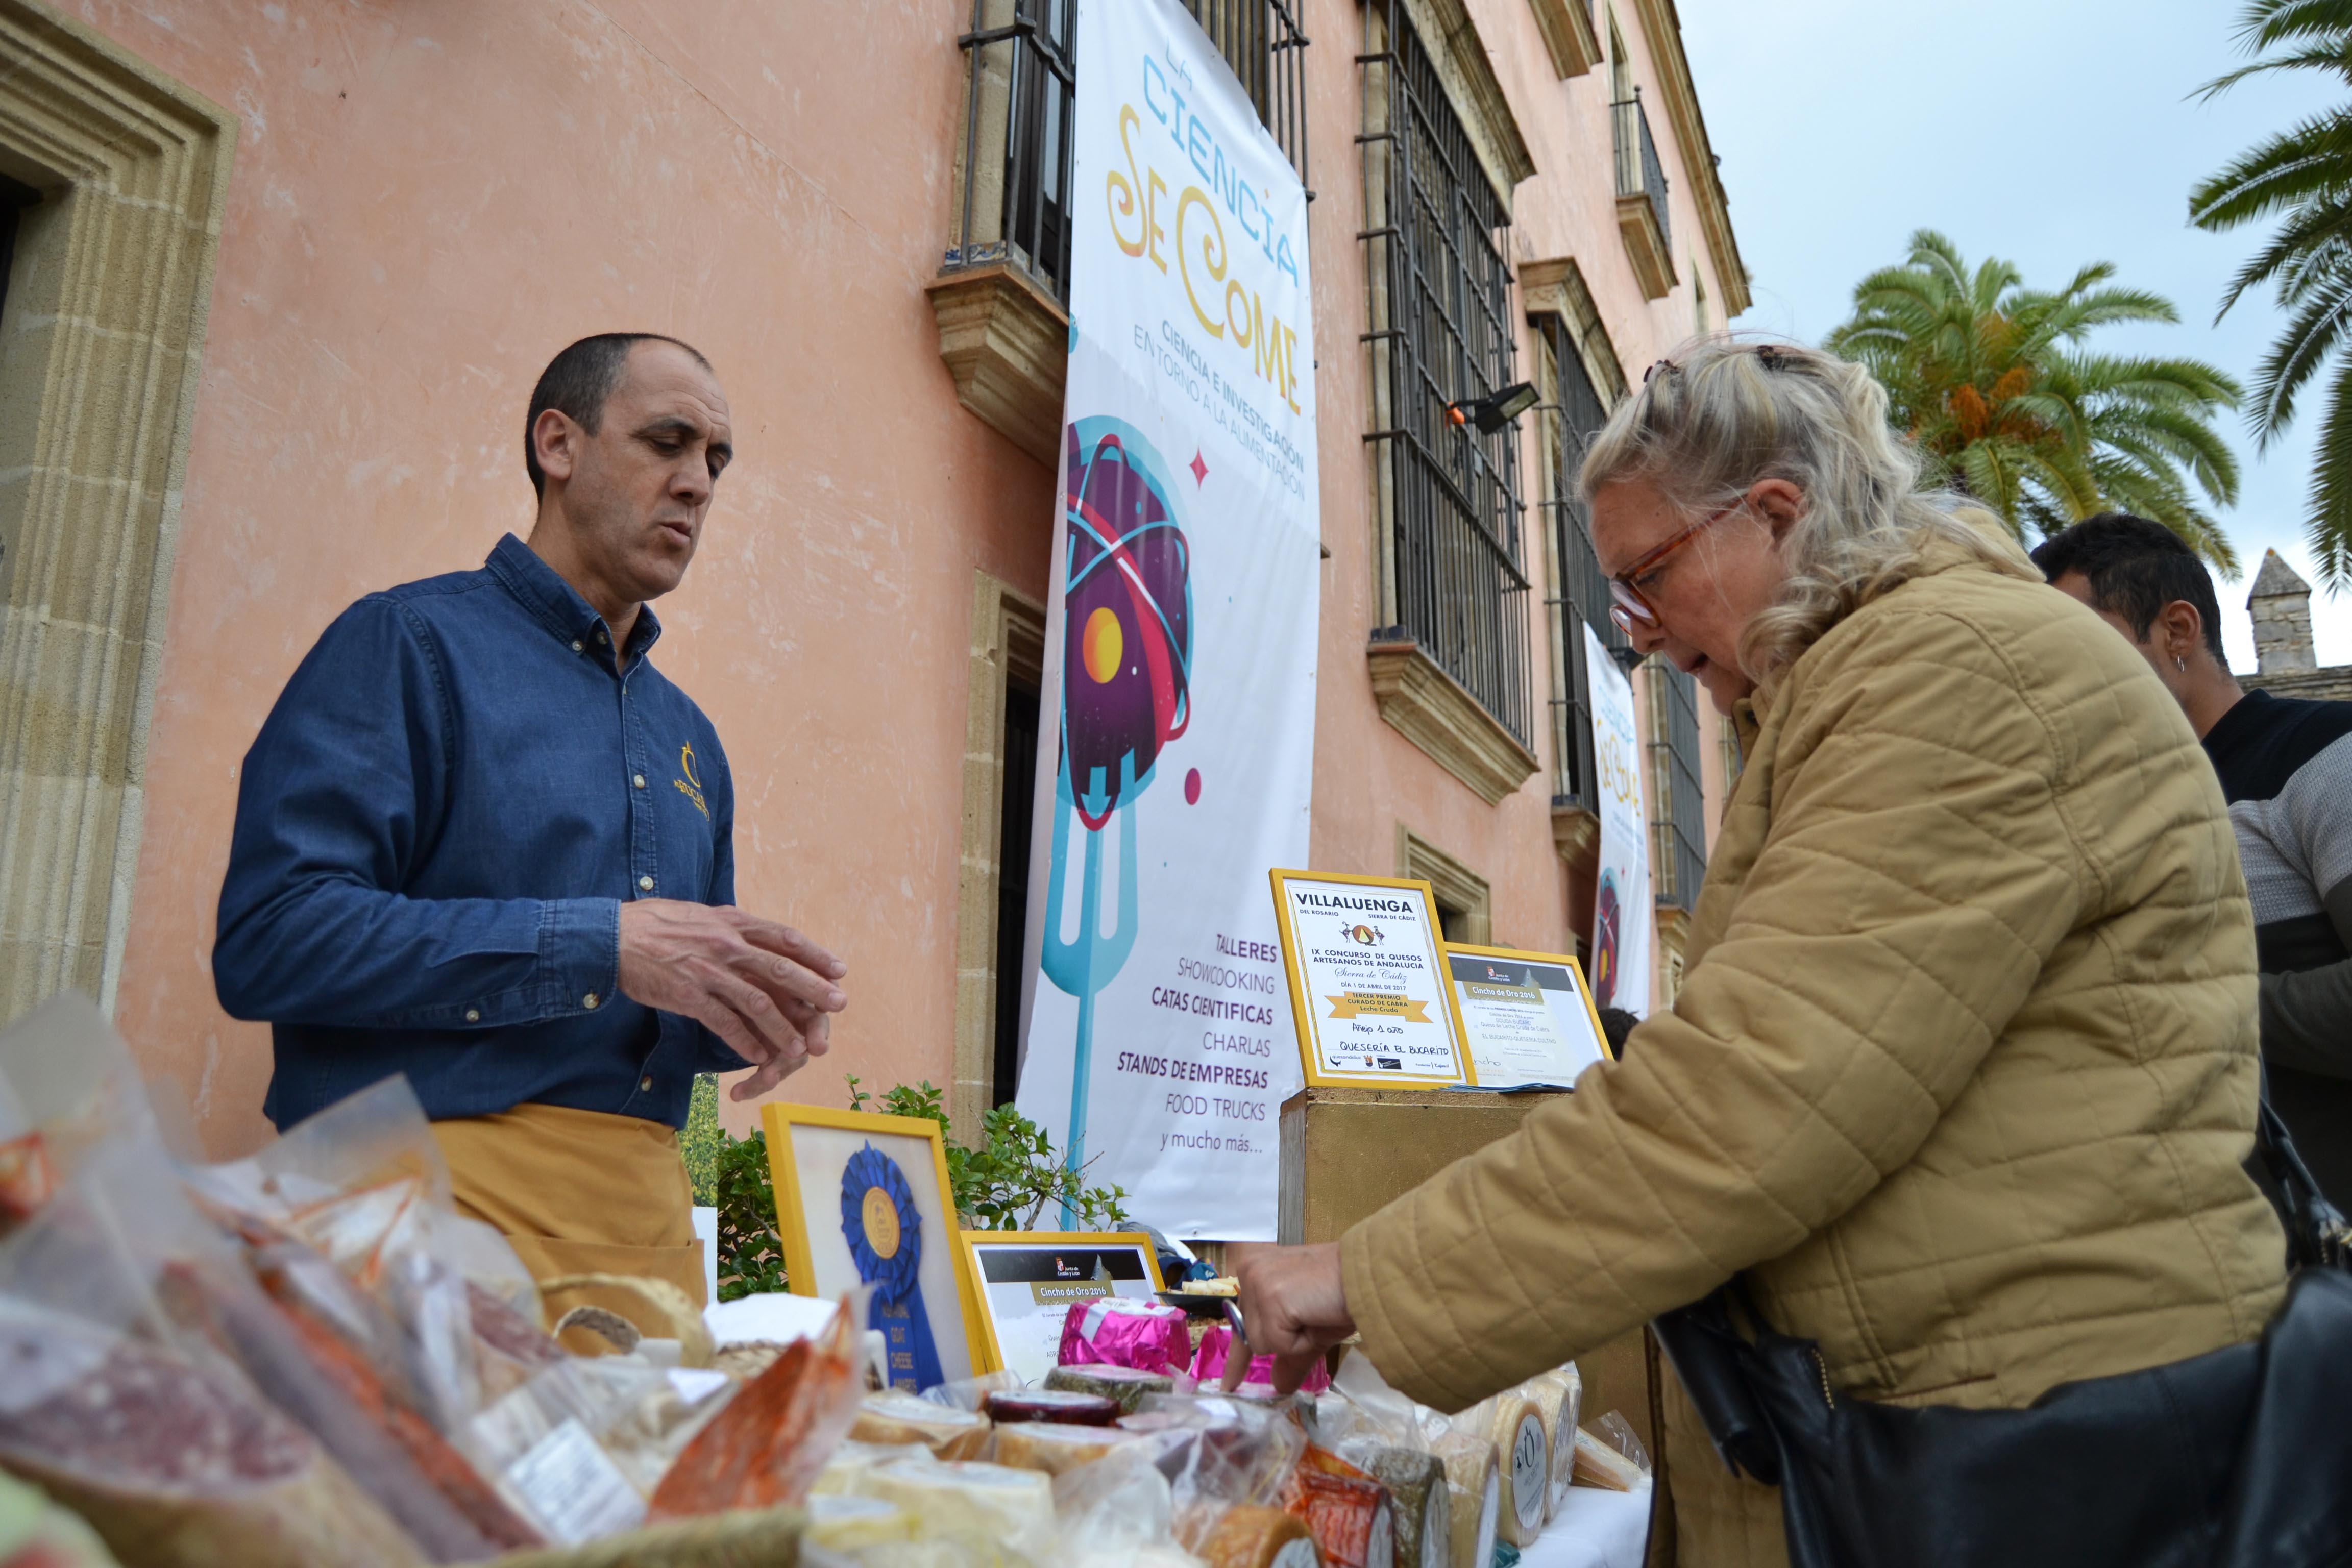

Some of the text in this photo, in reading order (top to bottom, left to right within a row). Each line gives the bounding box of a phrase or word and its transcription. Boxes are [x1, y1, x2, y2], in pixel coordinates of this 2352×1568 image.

[1166, 36, 1193, 91] LA
[1143, 54, 1298, 288] CIENCIA
[1162, 320, 1304, 474] CIENCIA E INVESTIGACIÓN
[1203, 393, 1211, 415] A
[1214, 401, 1228, 431] LA
[1230, 419, 1305, 502] ALIMENTACIÓN
[1295, 893, 1413, 913] VILLALUENGA
[1216, 934, 1277, 963] TALLERES
[1325, 949, 1371, 959] CONCURSO
[1389, 953, 1422, 962] QUESOS
[1178, 957, 1275, 995] SHOWCOOKING
[1313, 957, 1362, 966] ARTESANOS
[1377, 961, 1424, 969] ANDALUCIA
[1334, 967, 1408, 984] Sierra de Cádiz
[1472, 986, 1495, 996] Cincho
[1152, 986, 1273, 1026] CATAS CIENTIFICAS
[1353, 1023, 1373, 1035] Añejo
[1203, 1032, 1271, 1058] CHARLAS
[1340, 1041, 1449, 1055] QUESERÍA EL BUCARITO
[1117, 1051, 1268, 1089] STANDS DE EMPRESAS
[1165, 1093, 1266, 1121] FOOD TRUCKS
[1160, 1132, 1169, 1153] y
[1171, 1130, 1221, 1150] mucho
[1040, 1286, 1107, 1297] Cincho de Oro 2016
